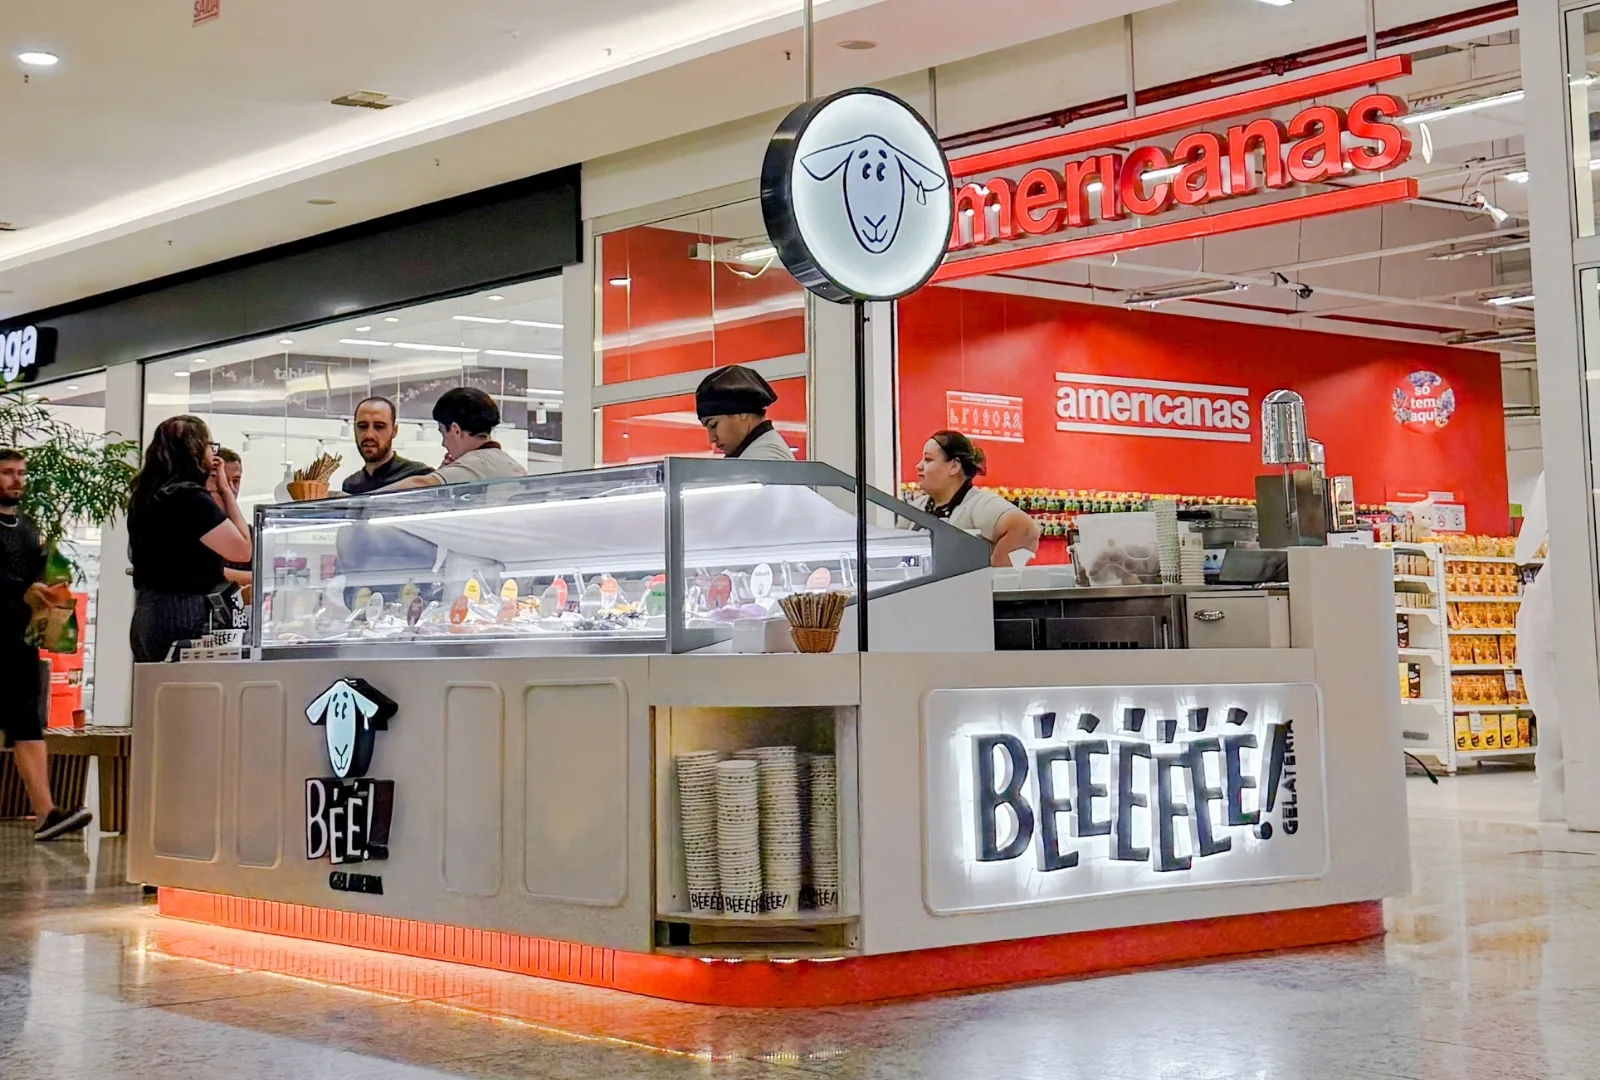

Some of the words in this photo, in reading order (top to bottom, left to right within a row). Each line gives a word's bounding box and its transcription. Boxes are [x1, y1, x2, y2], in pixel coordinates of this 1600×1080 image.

[949, 93, 1411, 252] mericanas
[1056, 386, 1250, 430] americanas
[1410, 397, 1436, 409] tem
[305, 778, 380, 865] BÉÉ!
